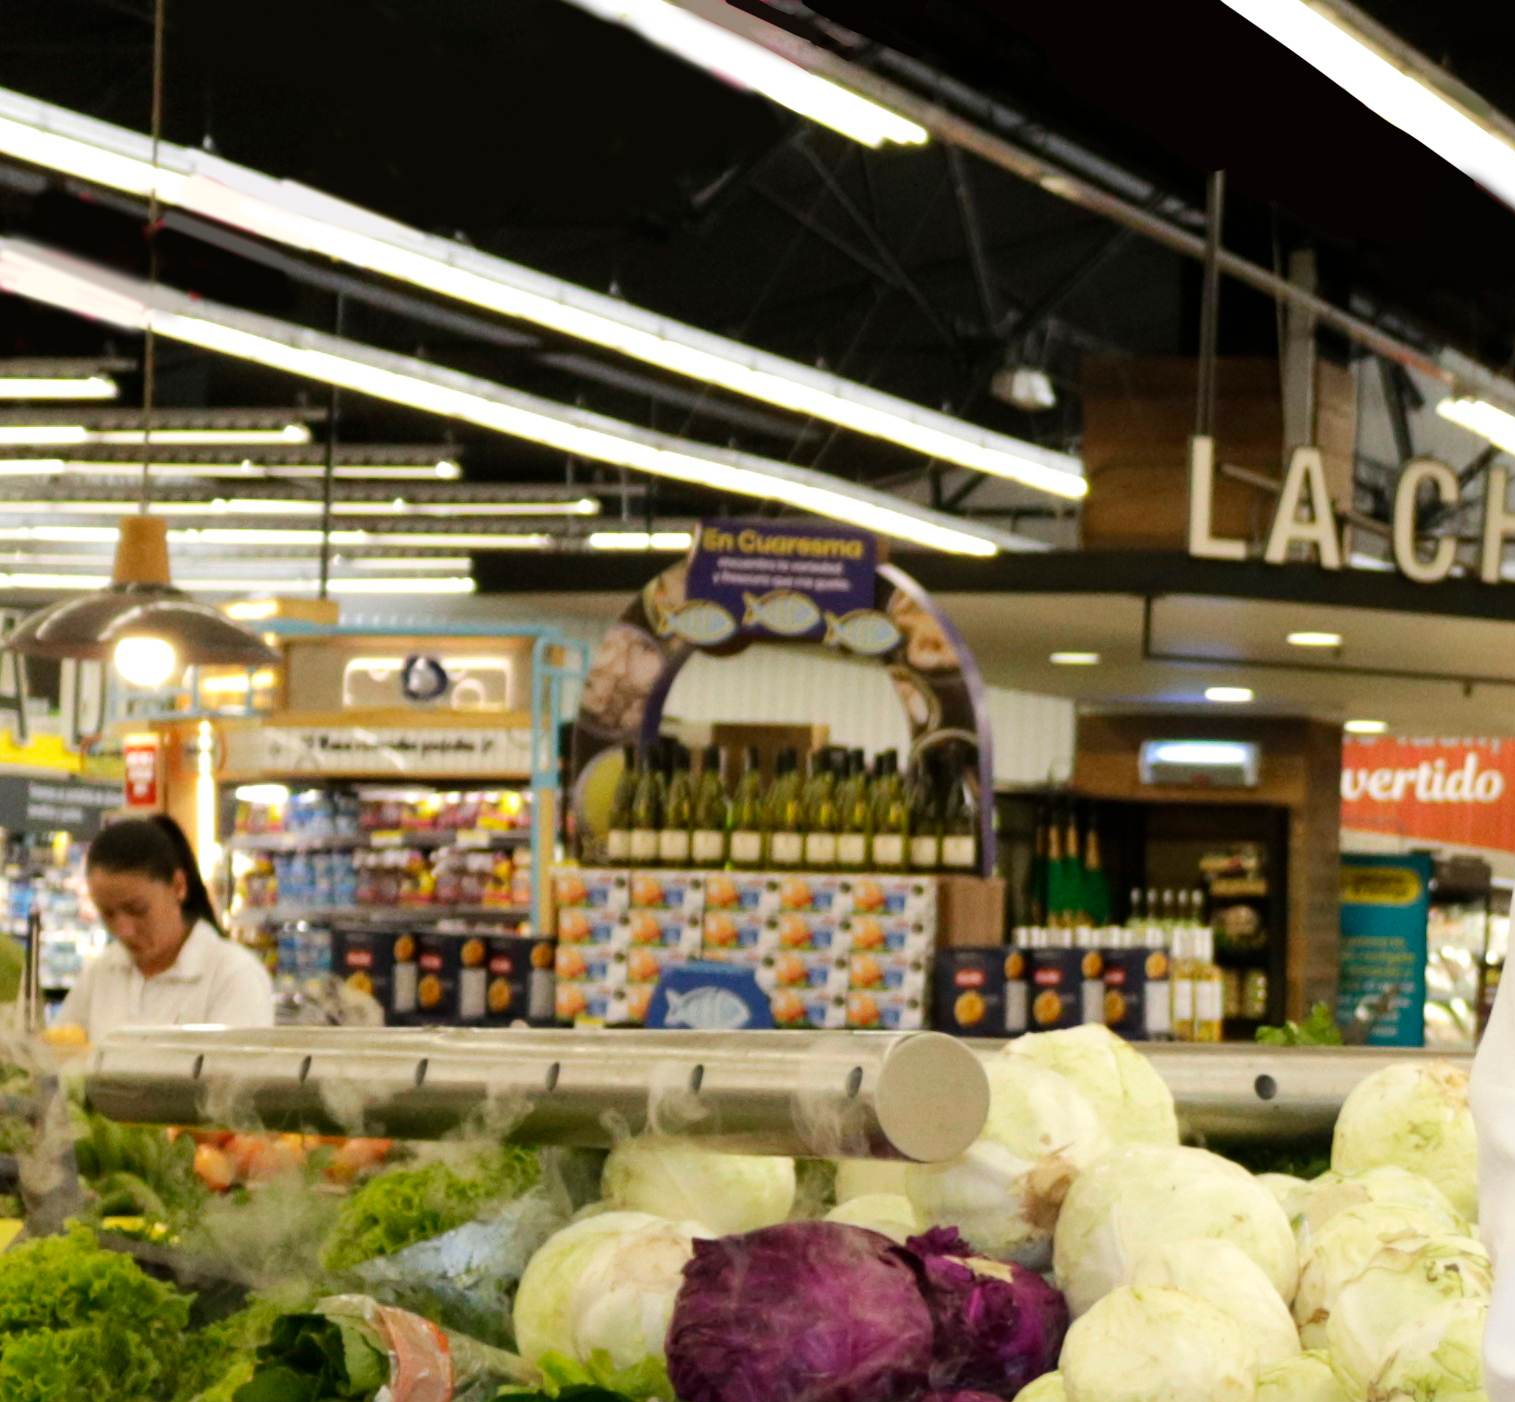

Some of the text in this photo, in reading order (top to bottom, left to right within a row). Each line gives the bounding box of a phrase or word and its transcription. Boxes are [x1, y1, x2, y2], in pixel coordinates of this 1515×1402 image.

[702, 527, 864, 560] En Cuaresma
[1188, 434, 1342, 571] LA
